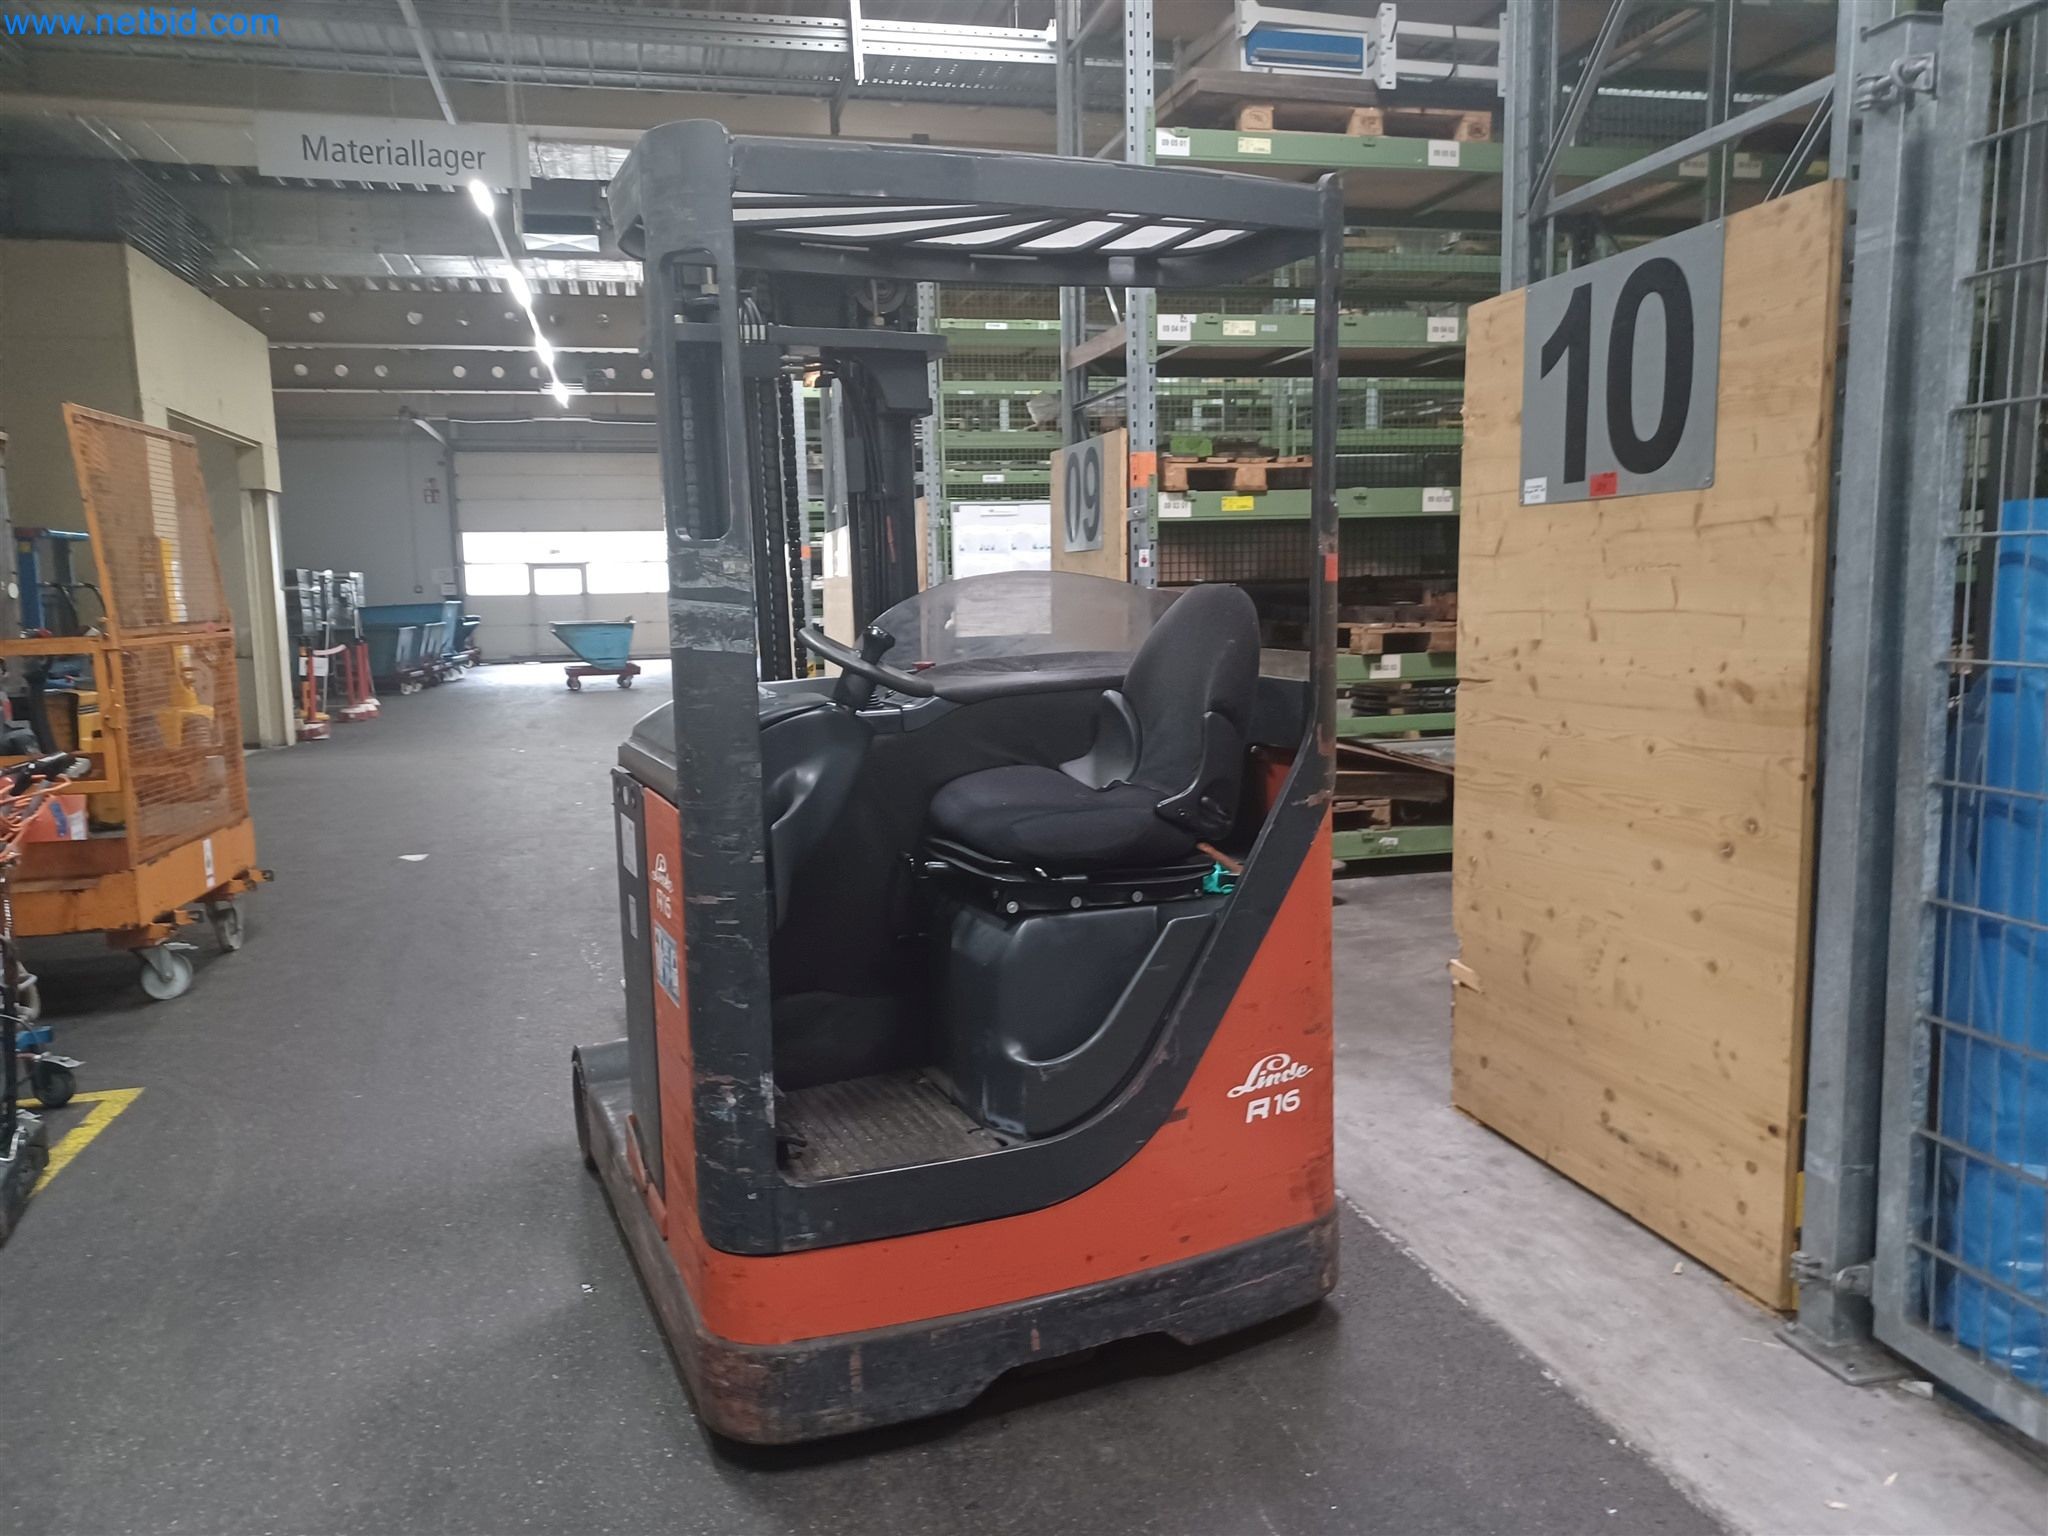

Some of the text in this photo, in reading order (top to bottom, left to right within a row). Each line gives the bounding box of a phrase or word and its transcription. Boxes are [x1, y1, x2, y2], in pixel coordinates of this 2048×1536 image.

[301, 133, 487, 176] Materiallager
[1540, 257, 1695, 485] 10
[1064, 446, 1101, 543] 09
[1226, 1053, 1314, 1098] Linde
